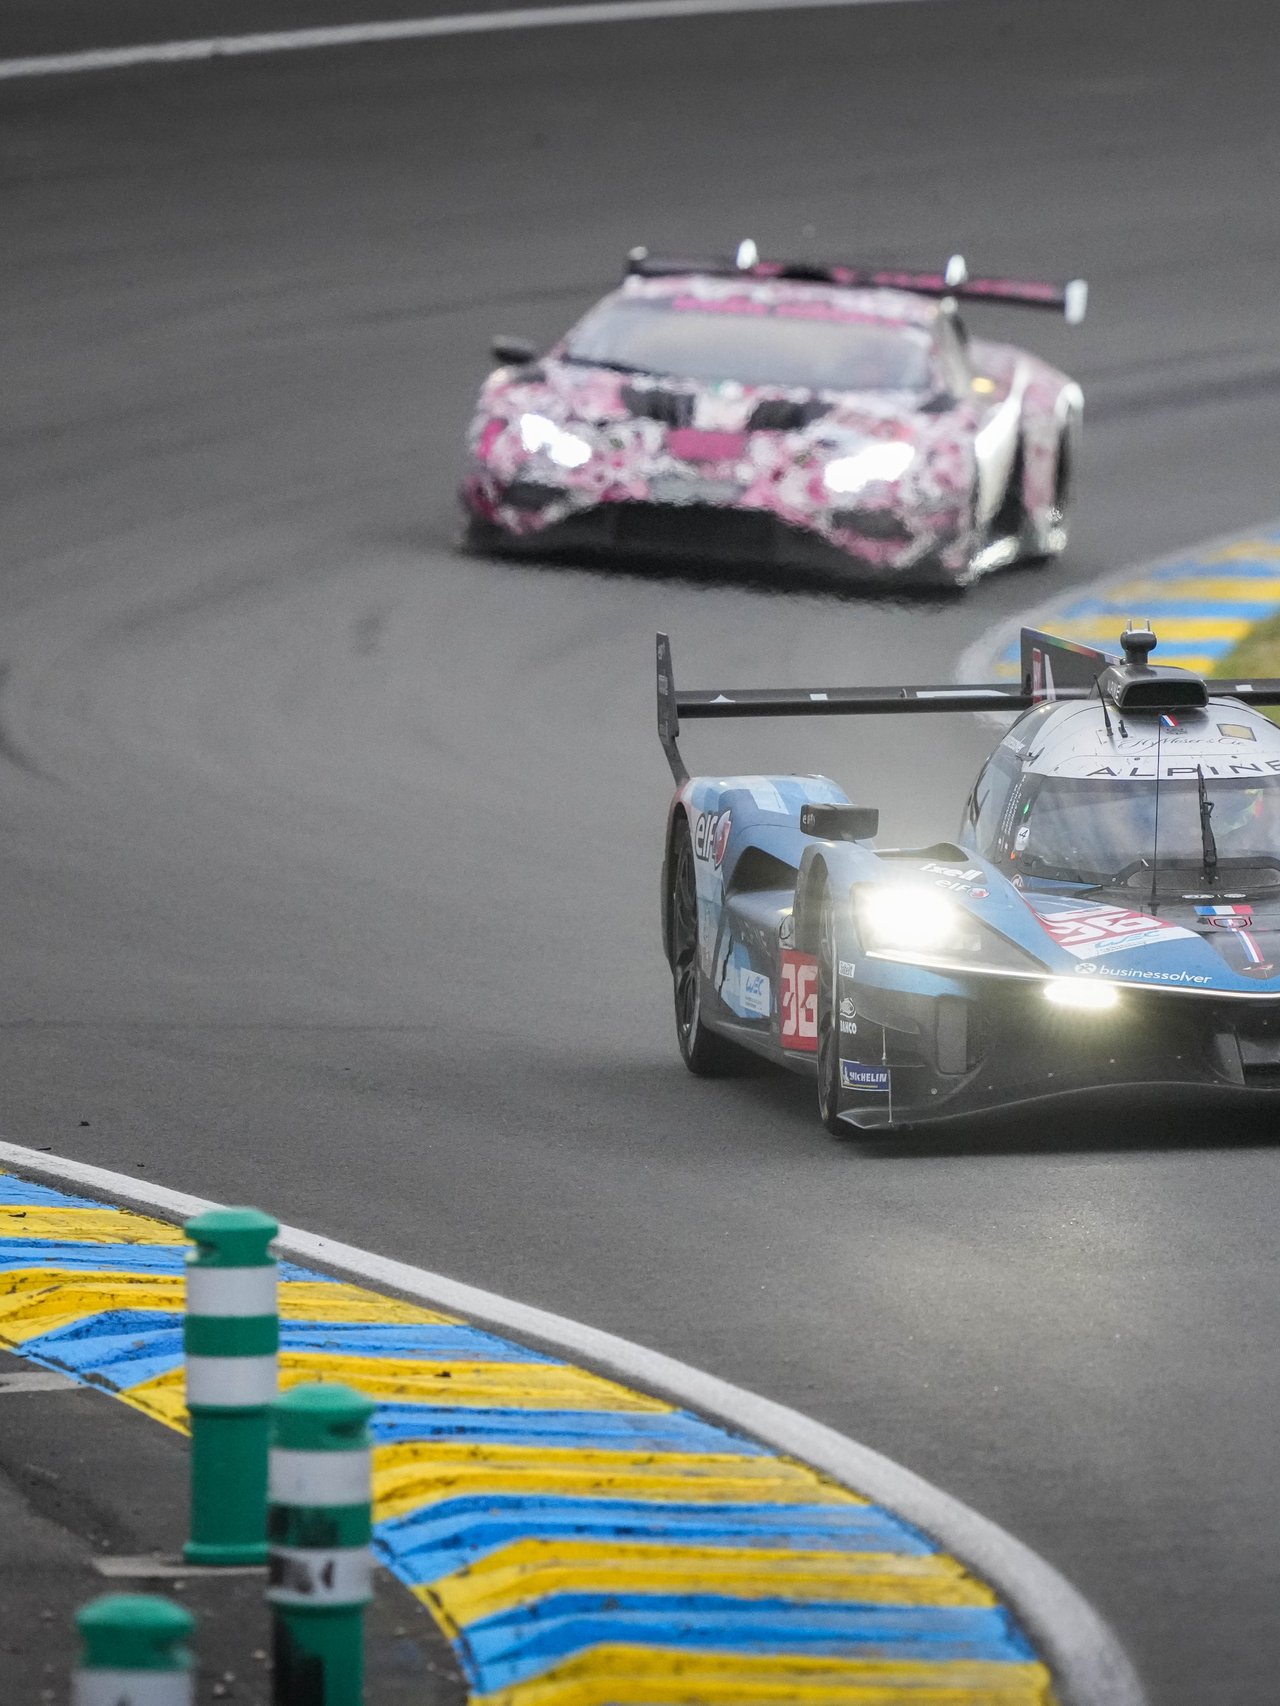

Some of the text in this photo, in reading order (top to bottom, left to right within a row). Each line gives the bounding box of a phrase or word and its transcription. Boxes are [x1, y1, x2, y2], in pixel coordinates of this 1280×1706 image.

[696, 814, 719, 859] elf
[935, 880, 971, 892] elf
[1100, 965, 1212, 984] businessolver
[781, 963, 818, 1038] 36
